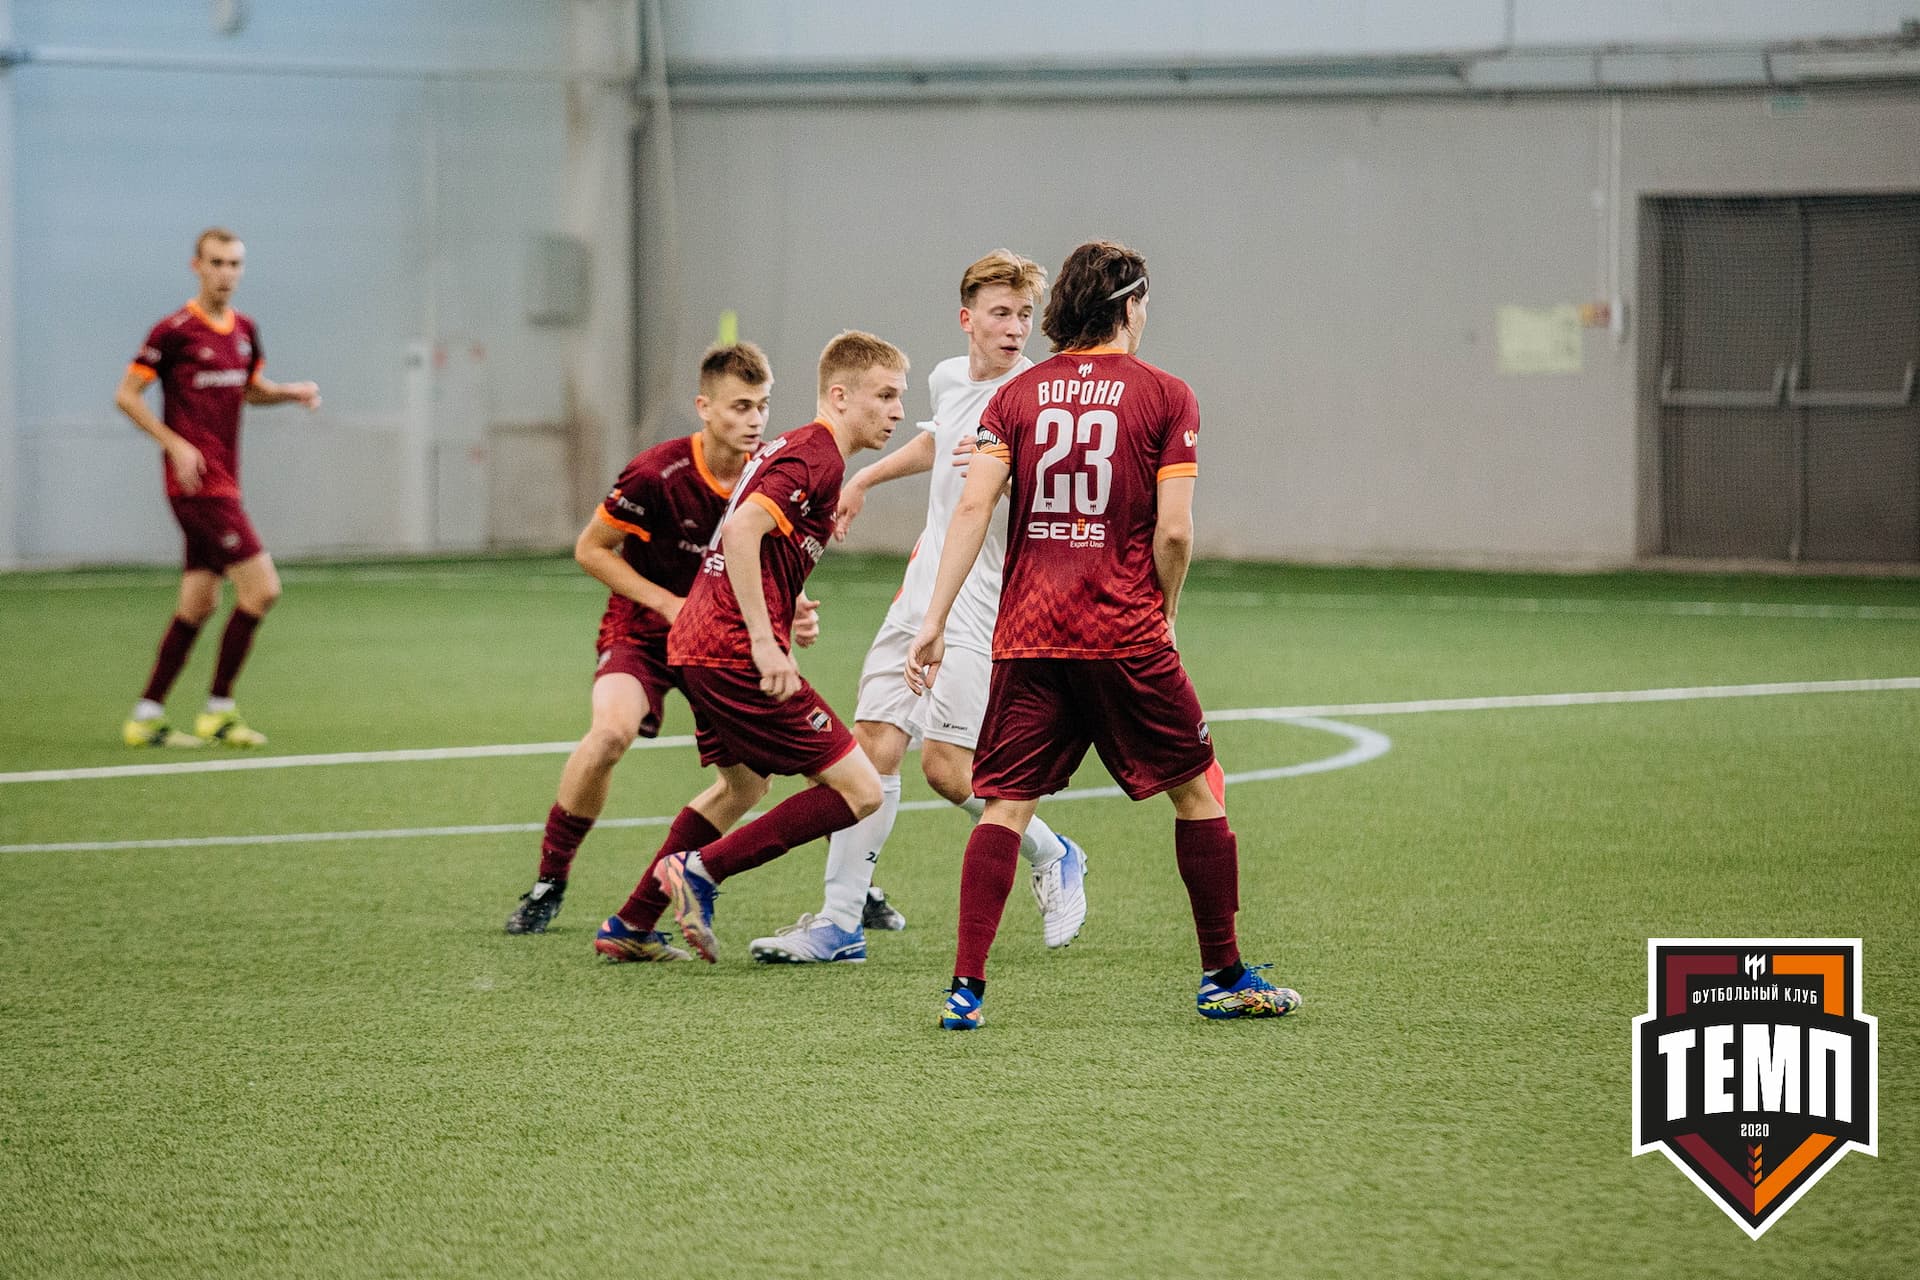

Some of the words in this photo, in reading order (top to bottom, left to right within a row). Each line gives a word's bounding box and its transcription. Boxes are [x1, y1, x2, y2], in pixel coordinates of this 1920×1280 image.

[1037, 379, 1125, 407] ВОРОНА
[1031, 407, 1119, 516] 23
[1027, 519, 1106, 541] SEUS
